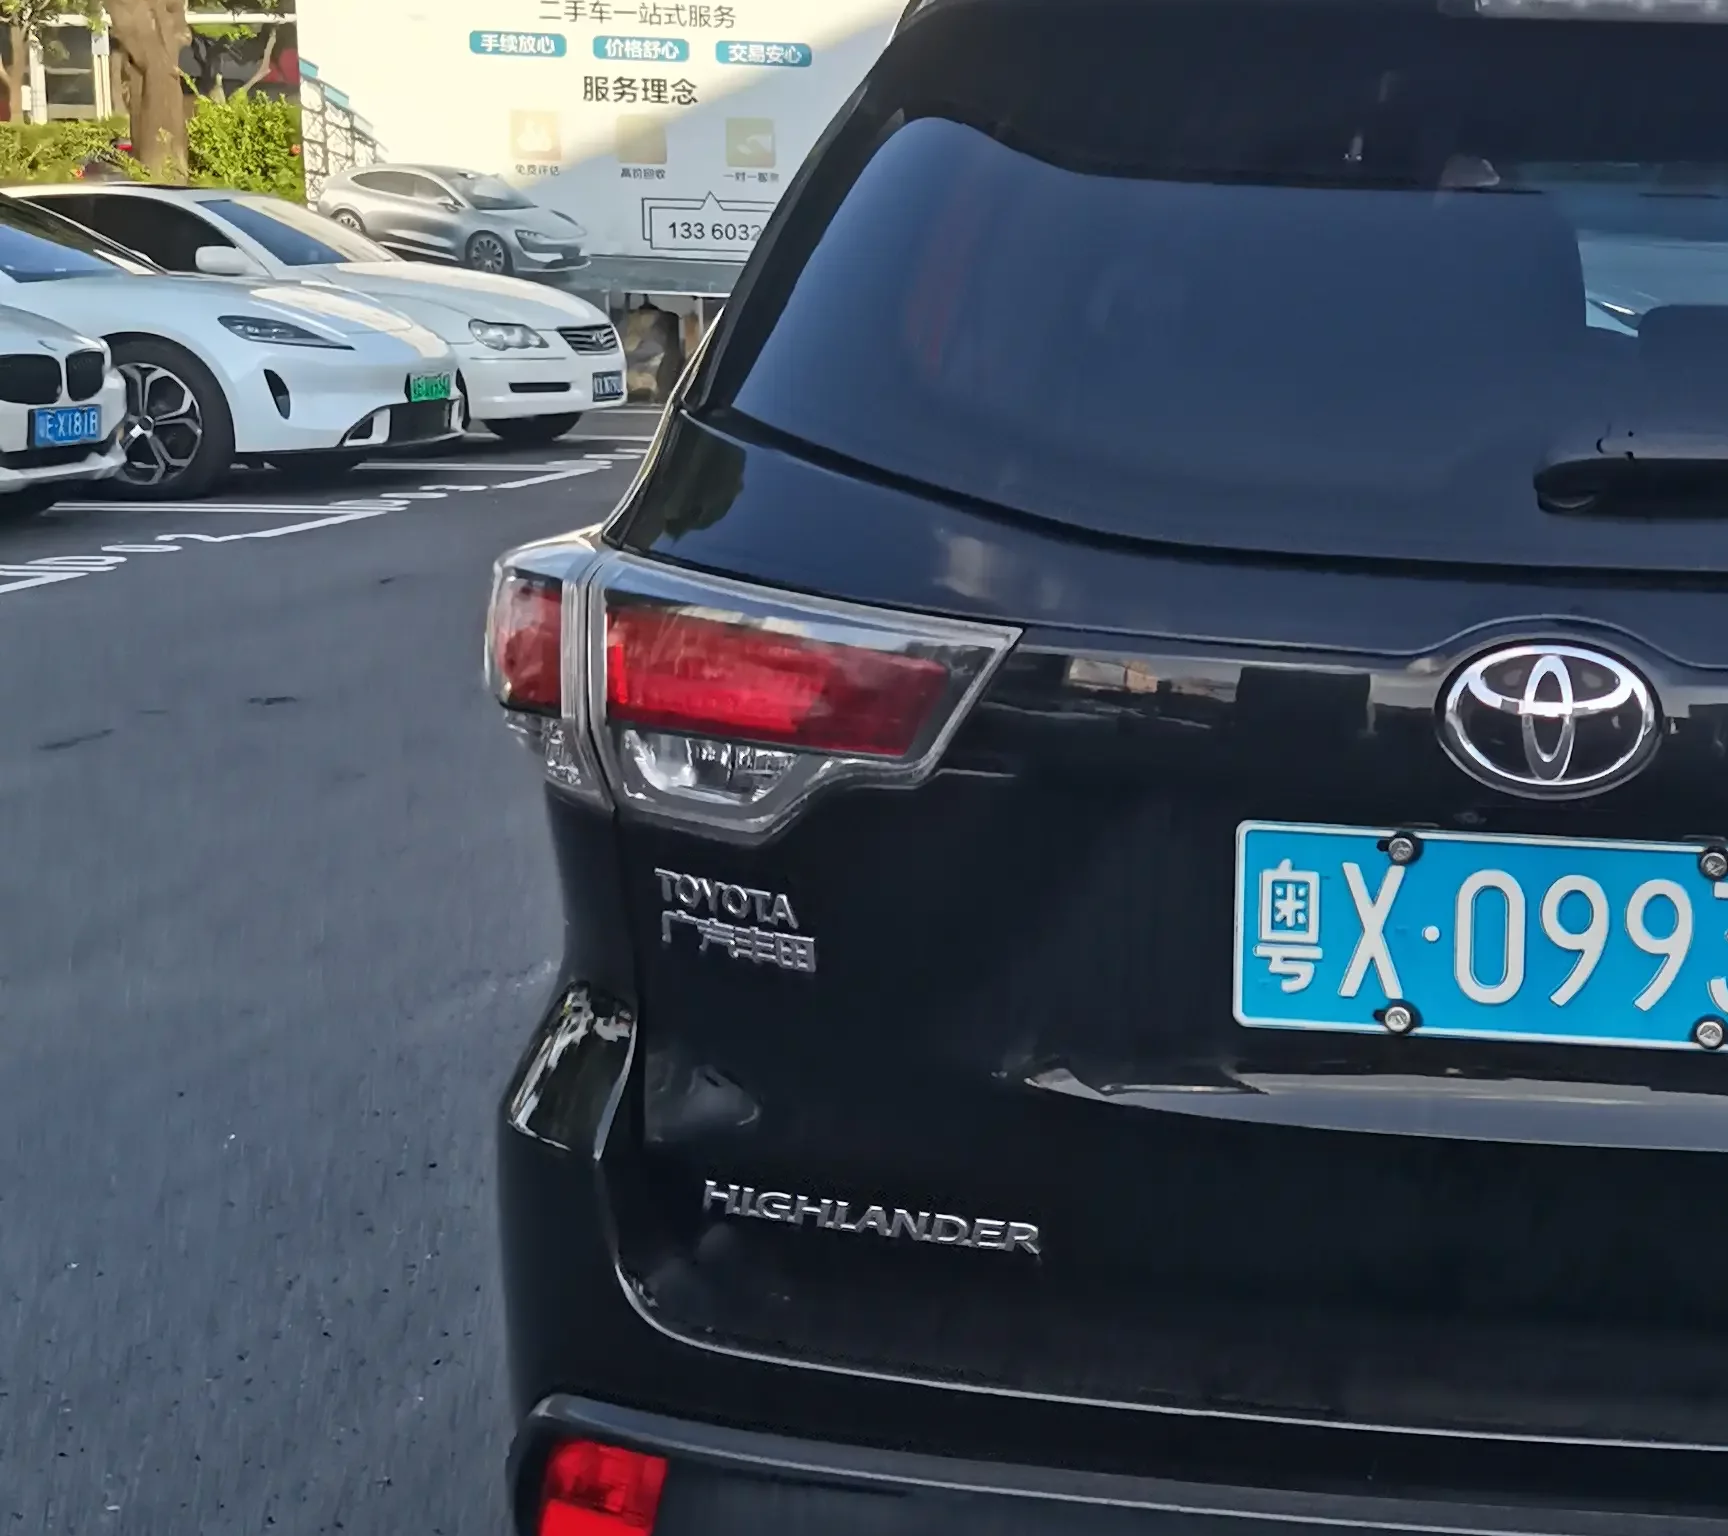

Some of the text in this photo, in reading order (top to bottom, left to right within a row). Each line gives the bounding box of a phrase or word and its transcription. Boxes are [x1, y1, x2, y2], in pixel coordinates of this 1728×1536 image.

[539, 0, 736, 29] 二手车一站式服务
[480, 34, 556, 54] 手续放心
[604, 38, 680, 60] 价格舒心
[727, 44, 803, 64] 交易安心
[582, 75, 699, 106] 服务理念
[668, 221, 705, 240] 133
[654, 867, 799, 930] TOYOTA
[704, 1178, 1042, 1256] HIGHLANDER
